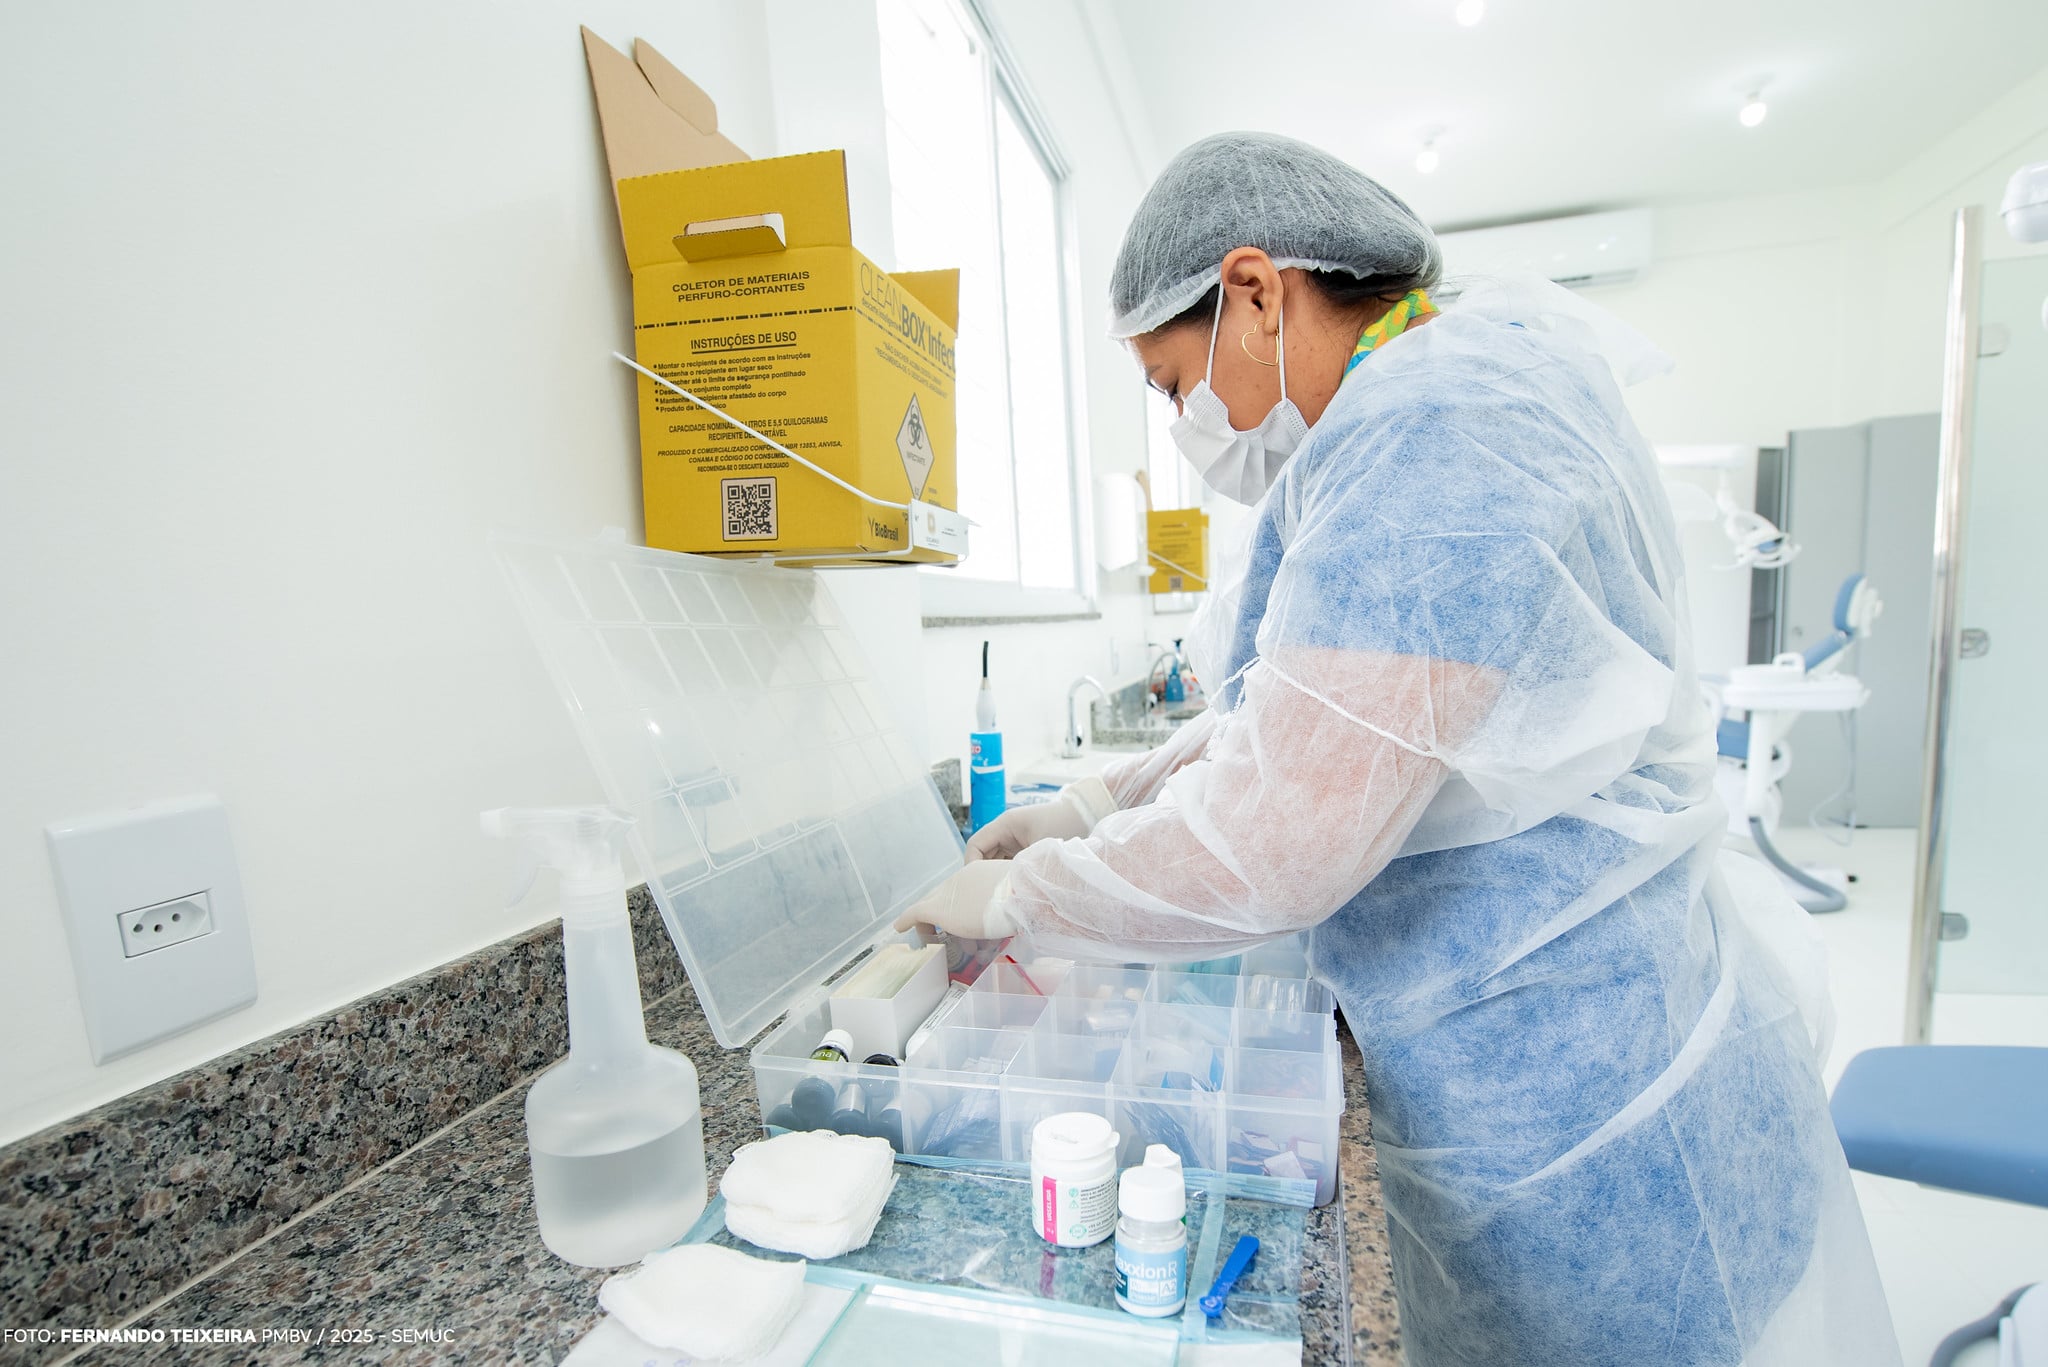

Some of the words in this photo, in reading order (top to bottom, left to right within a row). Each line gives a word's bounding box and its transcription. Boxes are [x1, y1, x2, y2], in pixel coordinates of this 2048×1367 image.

[672, 280, 725, 292] COLETOR
[729, 278, 744, 286] DE
[747, 271, 810, 285] MATERIAIS
[678, 283, 805, 302] PERFURO-CORTANTES
[691, 333, 755, 349] INSTRUÇÕES
[758, 333, 772, 343] DE
[775, 331, 797, 342] USO
[686, 359, 717, 368] recipiente
[659, 370, 688, 378] Mantenha
[696, 366, 726, 375] recipiente
[739, 365, 755, 373] lugar
[737, 373, 770, 382] segurança
[772, 370, 806, 379] pontilhado
[694, 385, 720, 393] conjunto
[722, 383, 751, 391] completo
[669, 424, 706, 433] CAPACIDADE
[773, 419, 782, 427] 5,5
[784, 416, 828, 426] QUILOGRAMAS
[709, 432, 743, 440] RECIPIENTE
[697, 446, 749, 455] COMERCIALIZADO
